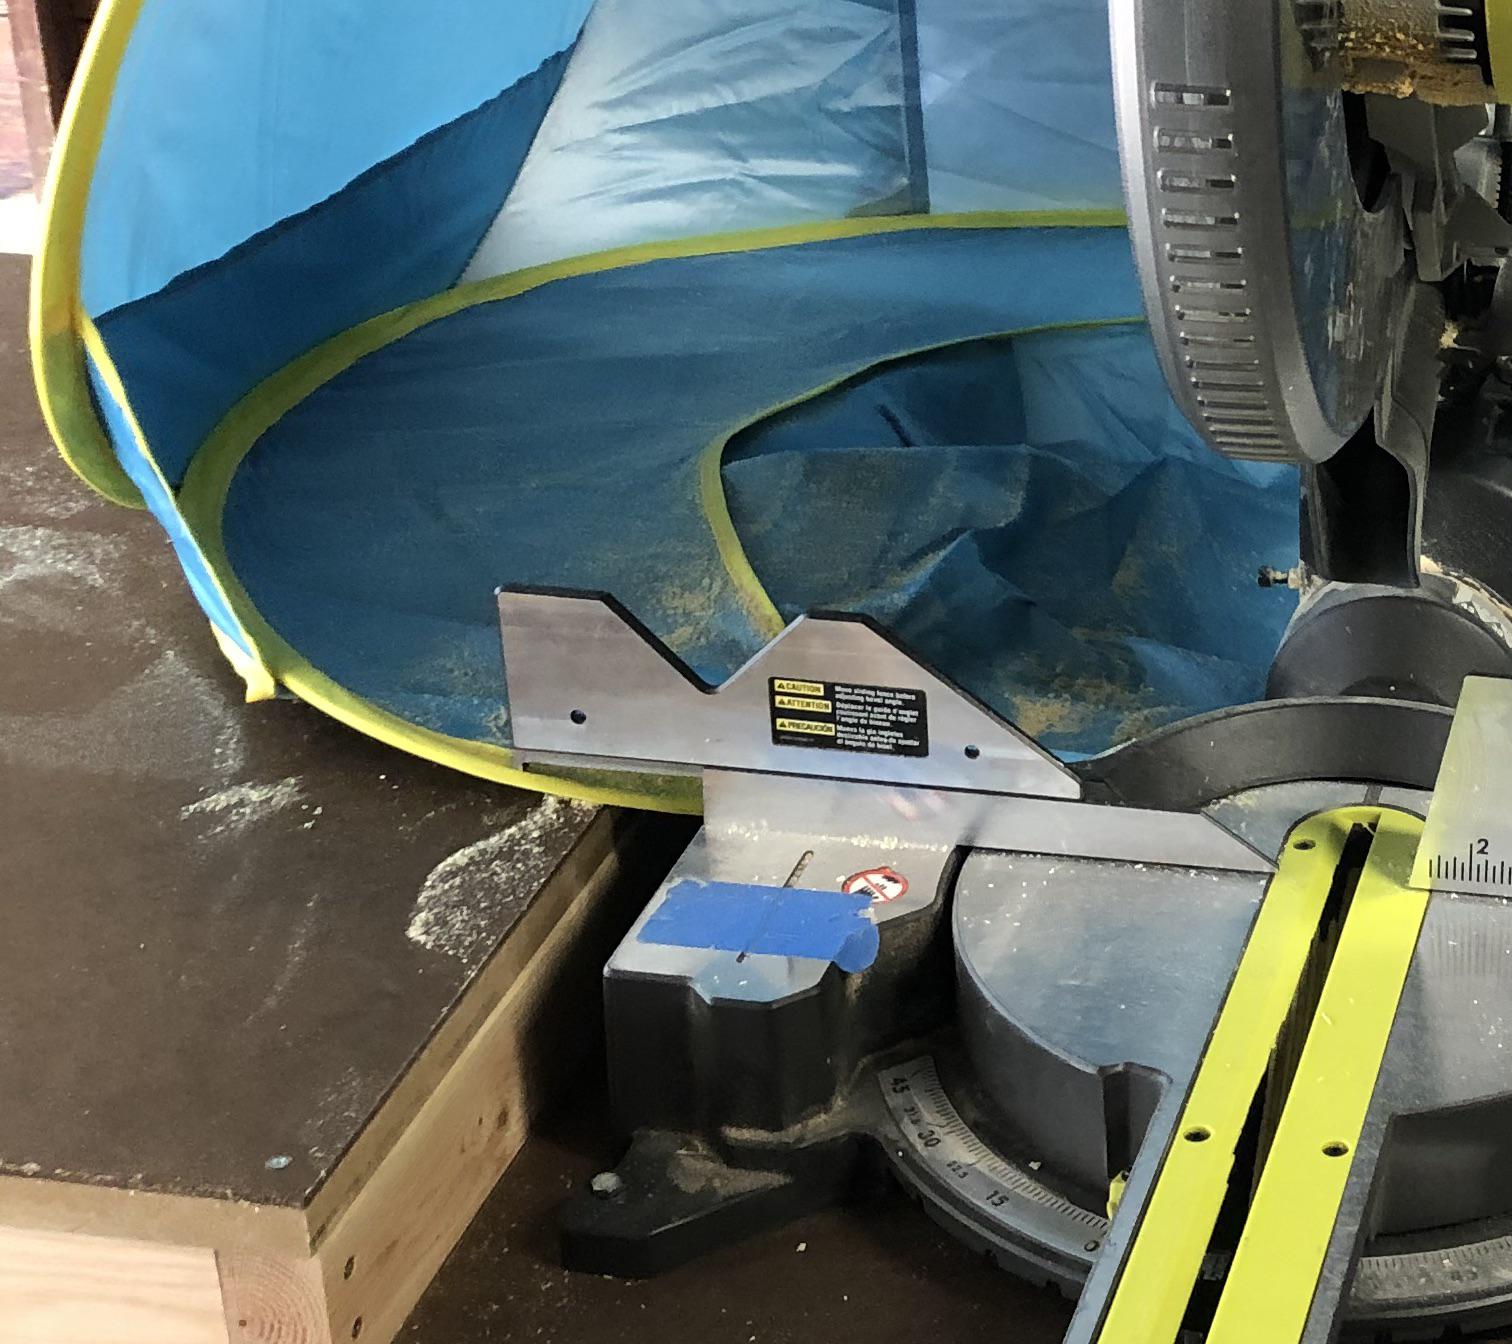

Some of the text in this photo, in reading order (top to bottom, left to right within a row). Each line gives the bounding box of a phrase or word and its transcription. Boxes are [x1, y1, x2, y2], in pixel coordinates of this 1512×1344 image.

[786, 682, 821, 693] CAUTION
[787, 699, 830, 711] ATTENTION
[1476, 838, 1490, 856] 2
[890, 1077, 910, 1093] 45
[917, 1129, 941, 1147] 30
[986, 1189, 1009, 1207] 15
[1083, 1239, 1100, 1252] 0
